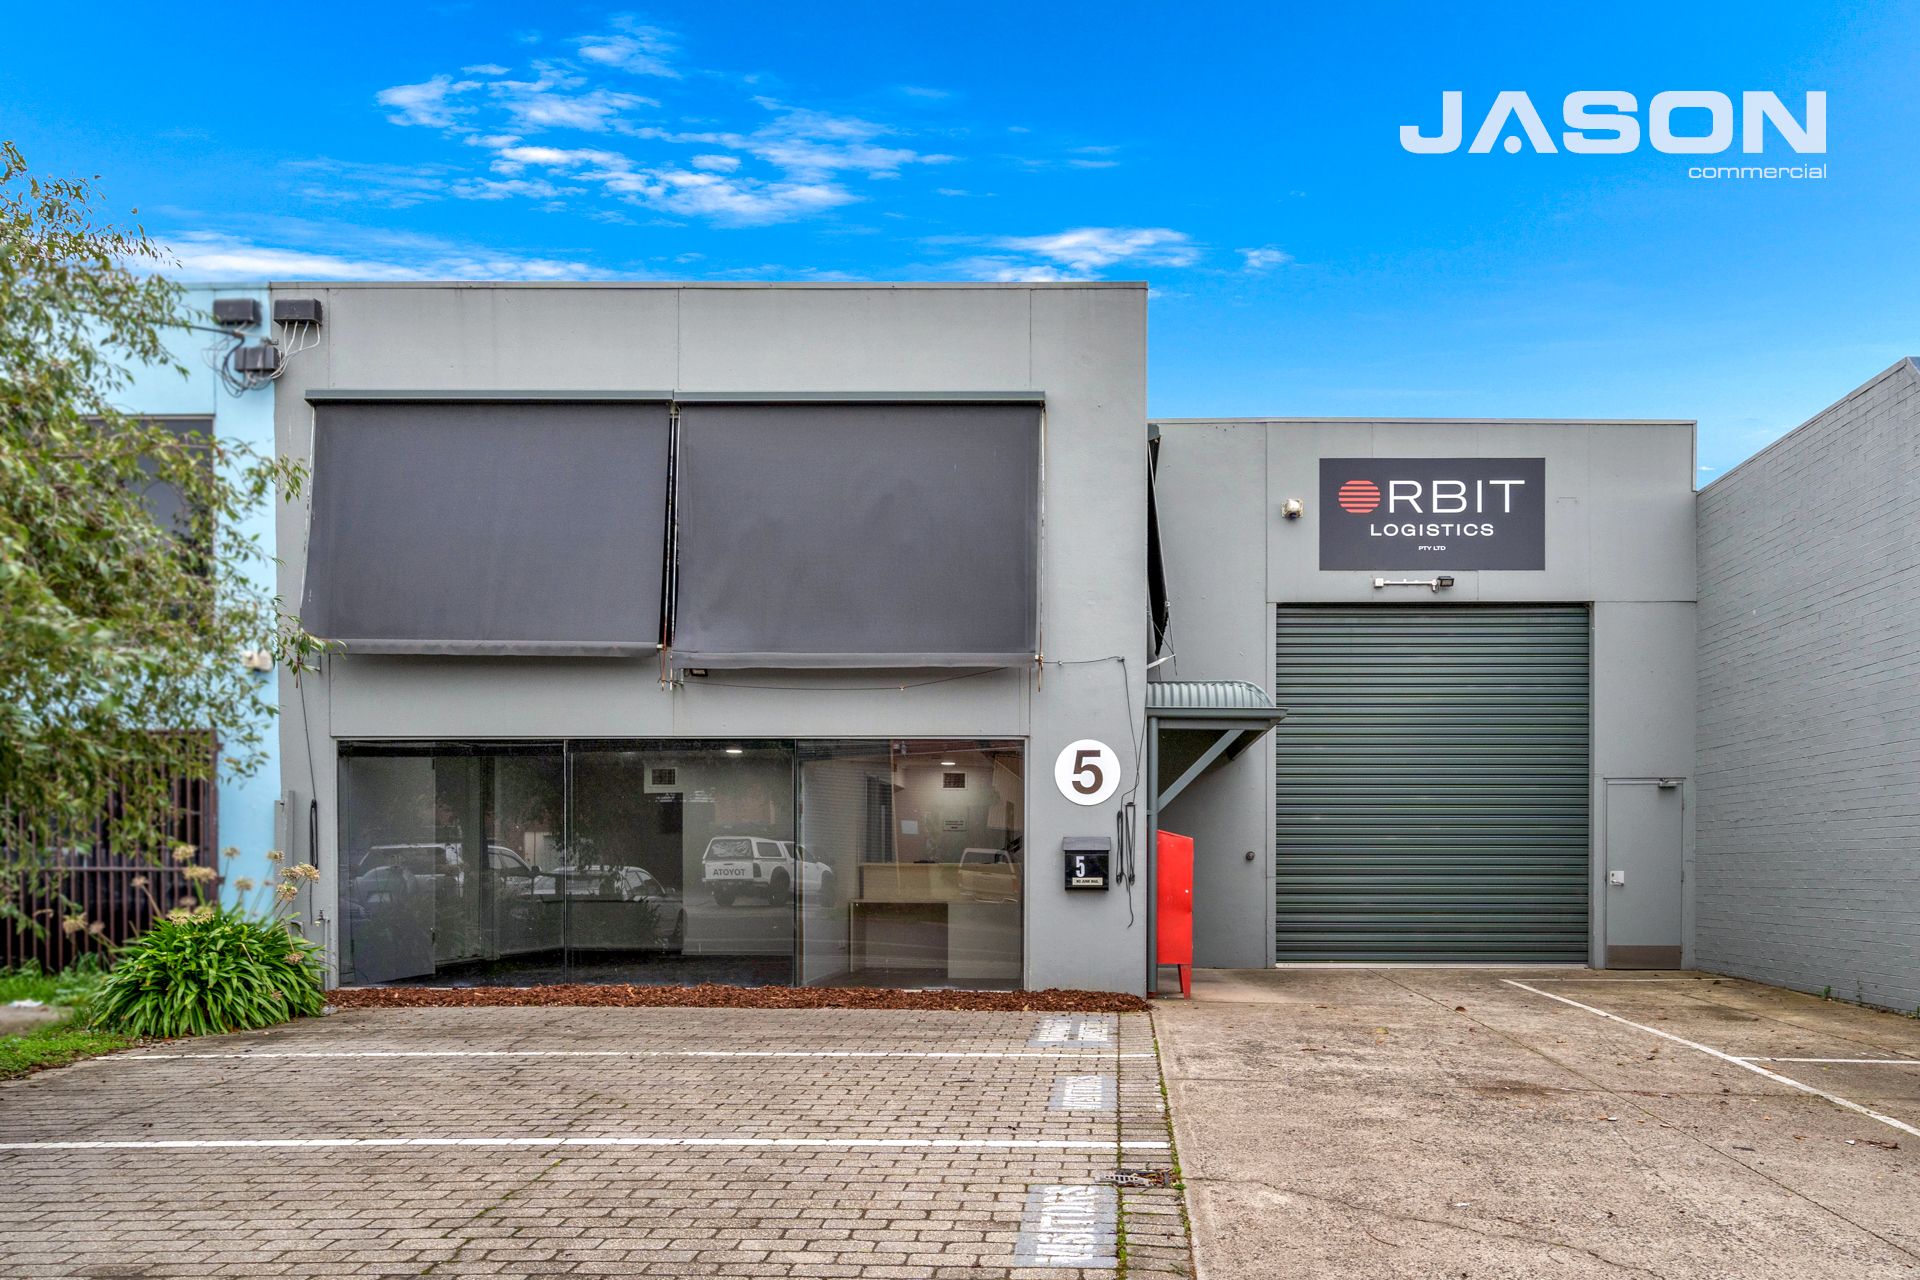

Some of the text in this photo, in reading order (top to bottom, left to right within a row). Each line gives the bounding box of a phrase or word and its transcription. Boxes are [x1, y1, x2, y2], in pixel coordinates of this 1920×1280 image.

[1370, 523, 1494, 537] LOGISTICS
[1072, 749, 1104, 795] 5
[1076, 855, 1085, 877] 5
[1035, 1186, 1096, 1263] VISITORS
